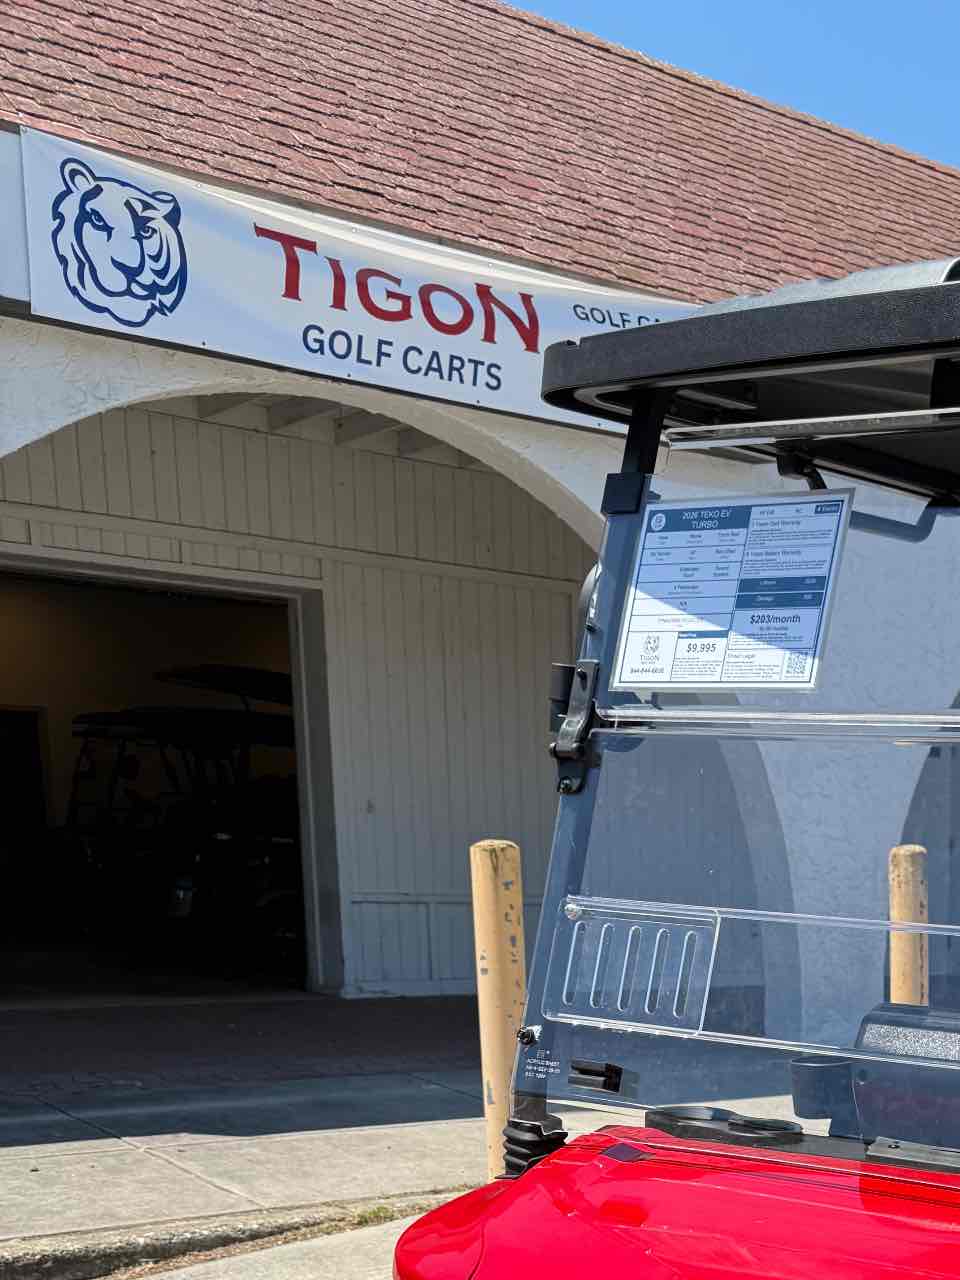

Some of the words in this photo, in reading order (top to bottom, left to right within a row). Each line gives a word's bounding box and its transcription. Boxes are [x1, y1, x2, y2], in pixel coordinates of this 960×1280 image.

[253, 223, 540, 353] TIGON
[572, 303, 632, 329] GOLF
[302, 324, 393, 367] GOLF
[402, 346, 502, 391] CARTS
